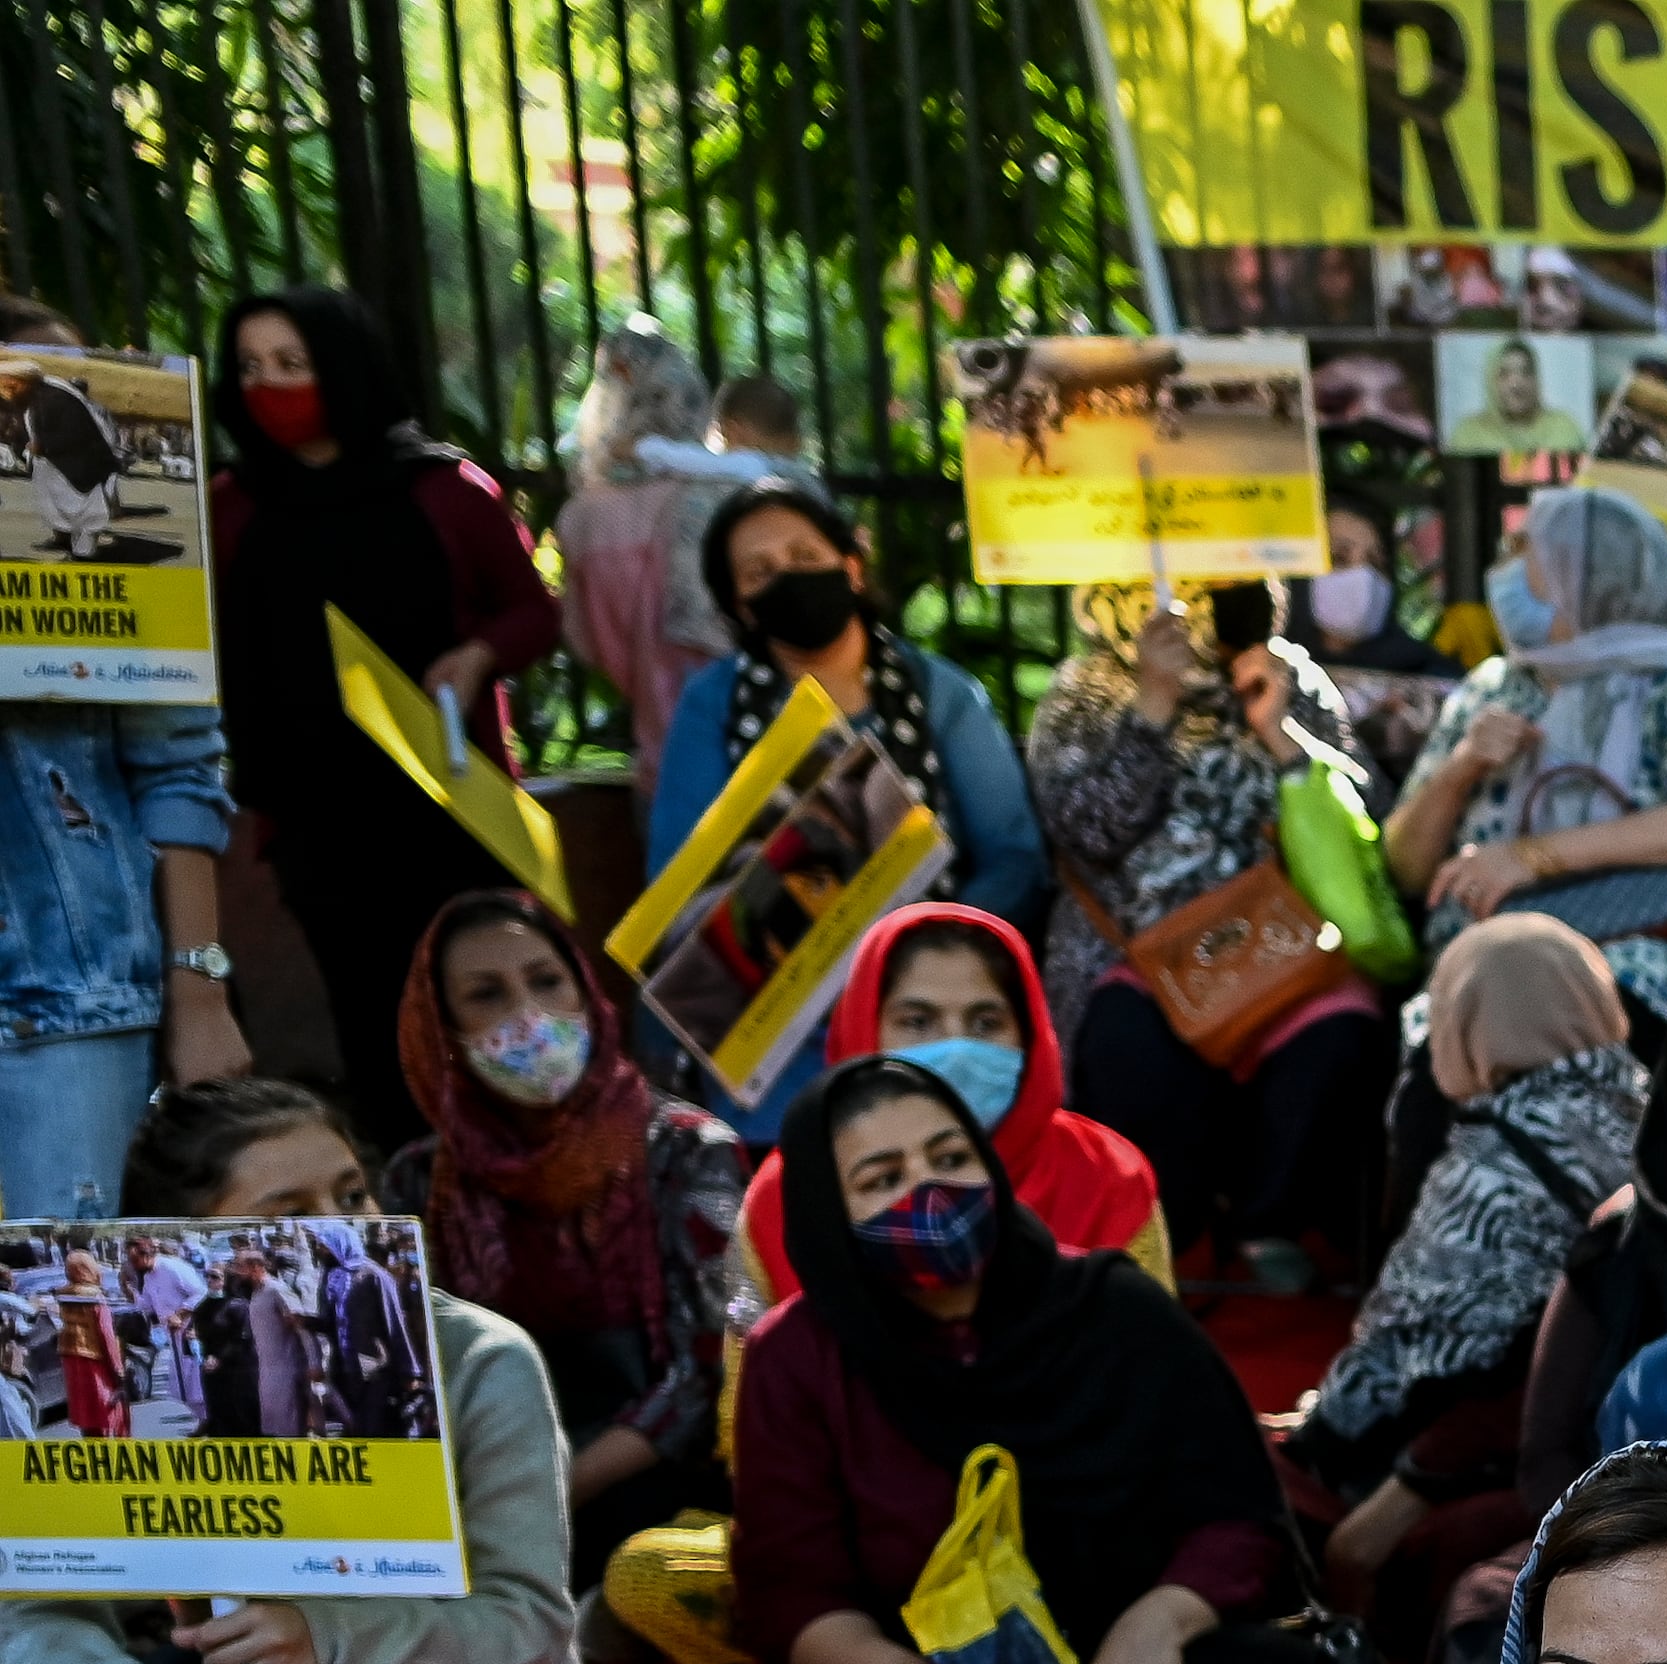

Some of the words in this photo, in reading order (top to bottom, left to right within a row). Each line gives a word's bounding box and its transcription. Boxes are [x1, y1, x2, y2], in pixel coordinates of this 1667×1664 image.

[40, 571, 69, 599] IN
[76, 572, 129, 602] THE
[31, 606, 138, 637] WOMEN
[23, 1441, 161, 1485] AFGHAN
[167, 1441, 298, 1484] WOMEN
[307, 1441, 372, 1485] ARE
[120, 1494, 285, 1537] FEARLESS
